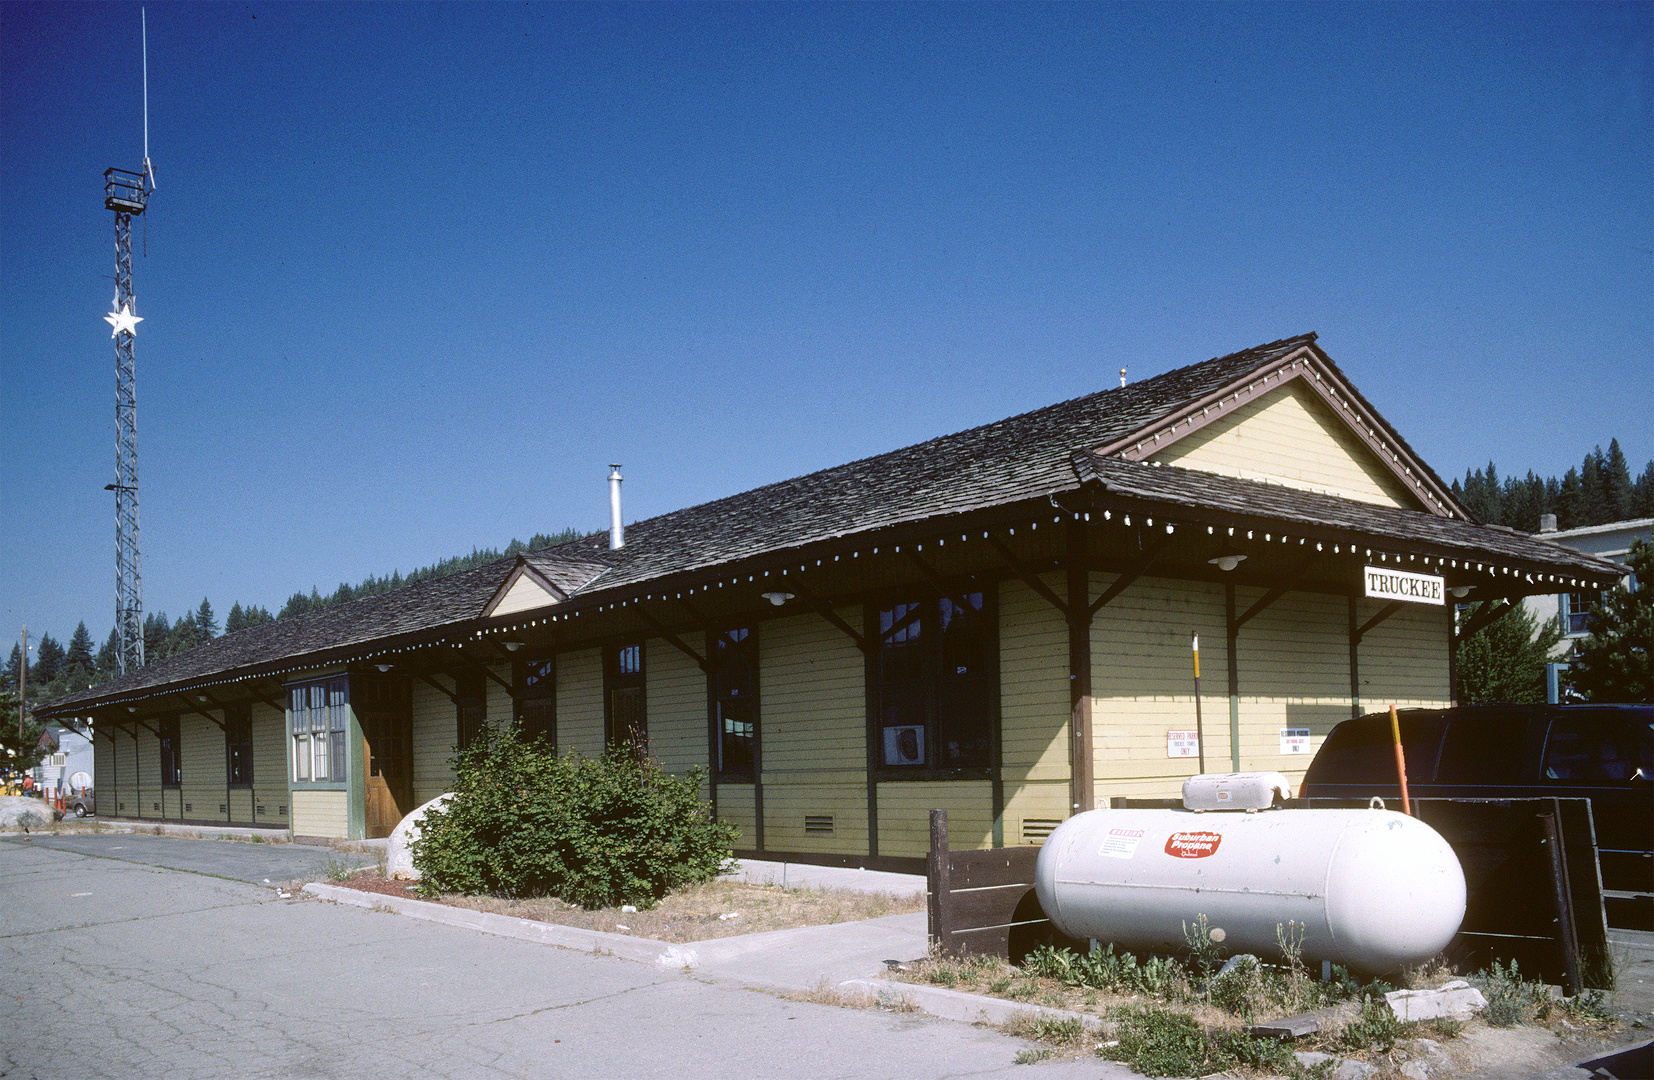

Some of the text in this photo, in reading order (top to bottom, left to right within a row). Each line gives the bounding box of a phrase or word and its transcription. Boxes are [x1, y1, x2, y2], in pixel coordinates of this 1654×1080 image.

[1367, 572, 1441, 600] TRUCKEE
[1167, 732, 1185, 740] RESERVED
[1172, 833, 1220, 842] Suburban
[1171, 841, 1213, 850] Propane
